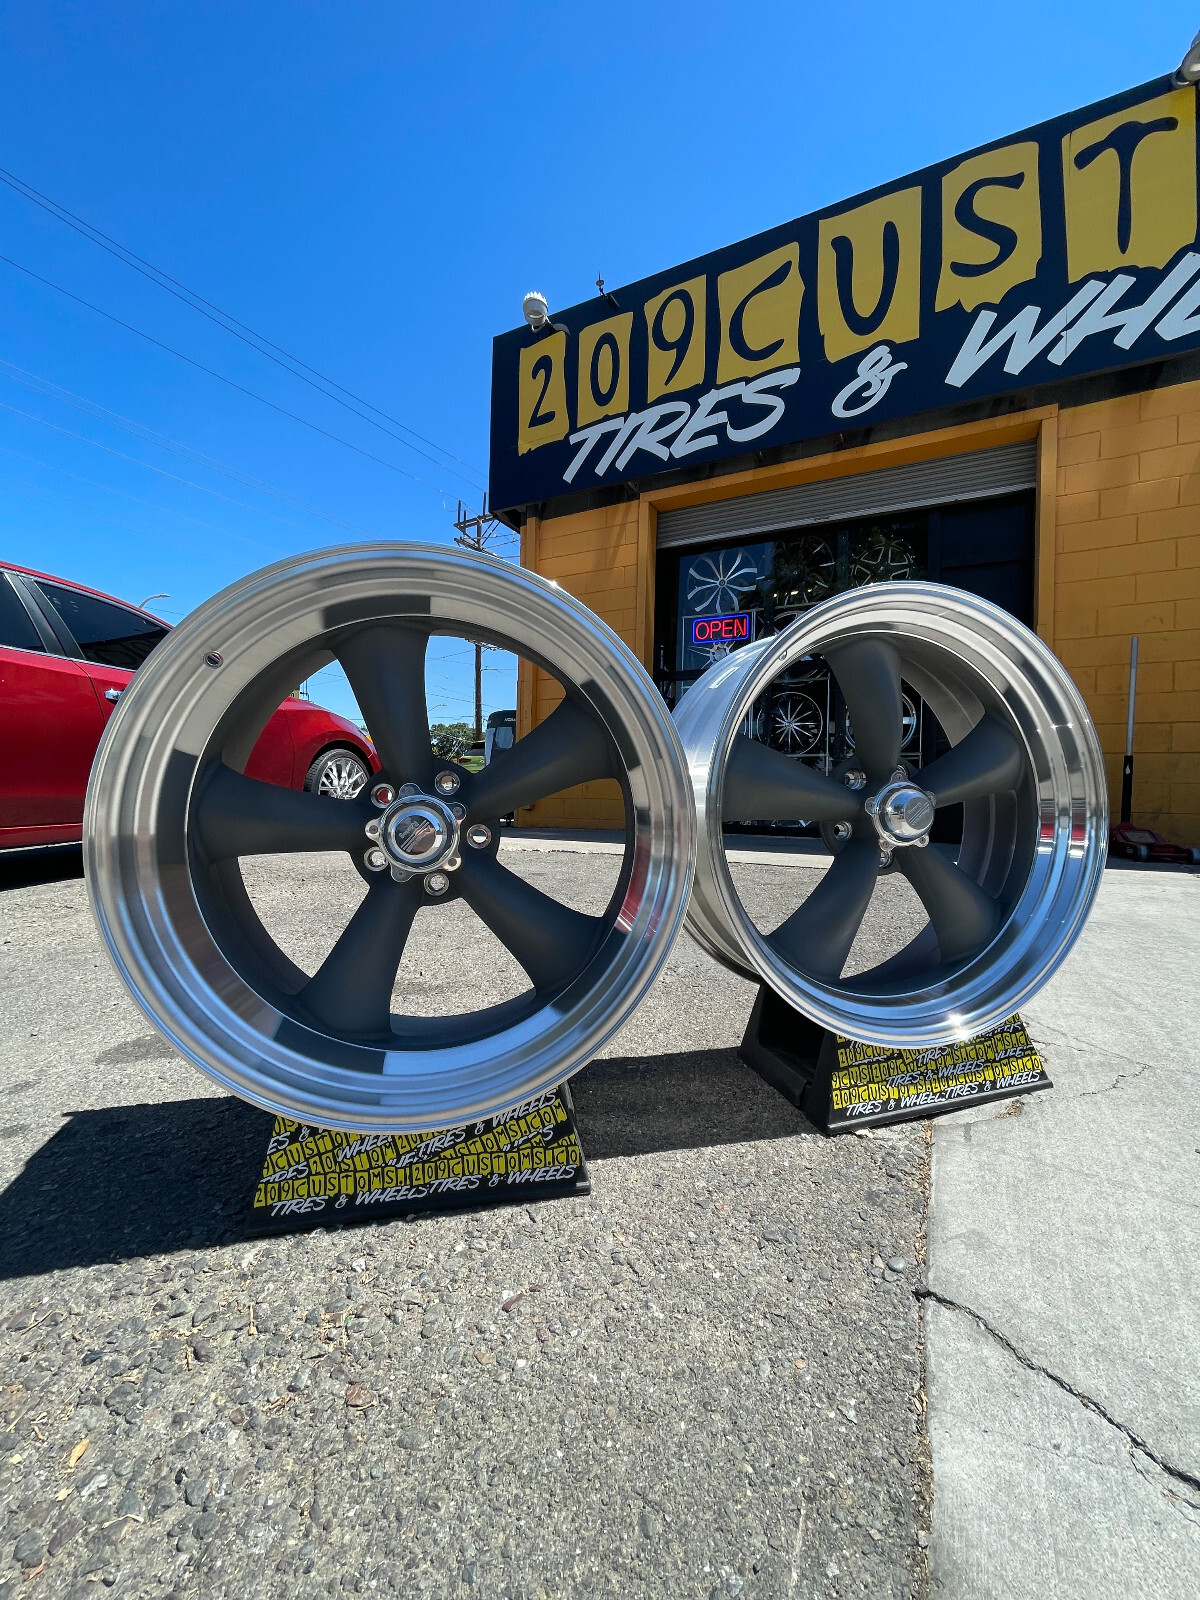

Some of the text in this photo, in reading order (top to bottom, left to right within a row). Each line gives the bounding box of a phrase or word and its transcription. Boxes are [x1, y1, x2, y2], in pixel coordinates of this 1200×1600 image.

[563, 368, 801, 484] TIRES
[831, 344, 908, 418] &
[695, 618, 748, 640] OPEN
[886, 1071, 921, 1088] TIRES
[938, 1060, 985, 1078] WHEELS
[945, 1082, 979, 1098] TIRES
[996, 1070, 1041, 1089] WHEELS
[846, 1090, 946, 1117] TIRES & WHEEL
[417, 1126, 467, 1158] TIRES
[475, 1122, 485, 1135] &
[493, 1089, 557, 1127] WHEELS
[429, 1164, 577, 1194] TIRES & WHEELS
[271, 1195, 330, 1217] TIRES
[335, 1193, 348, 1208] &
